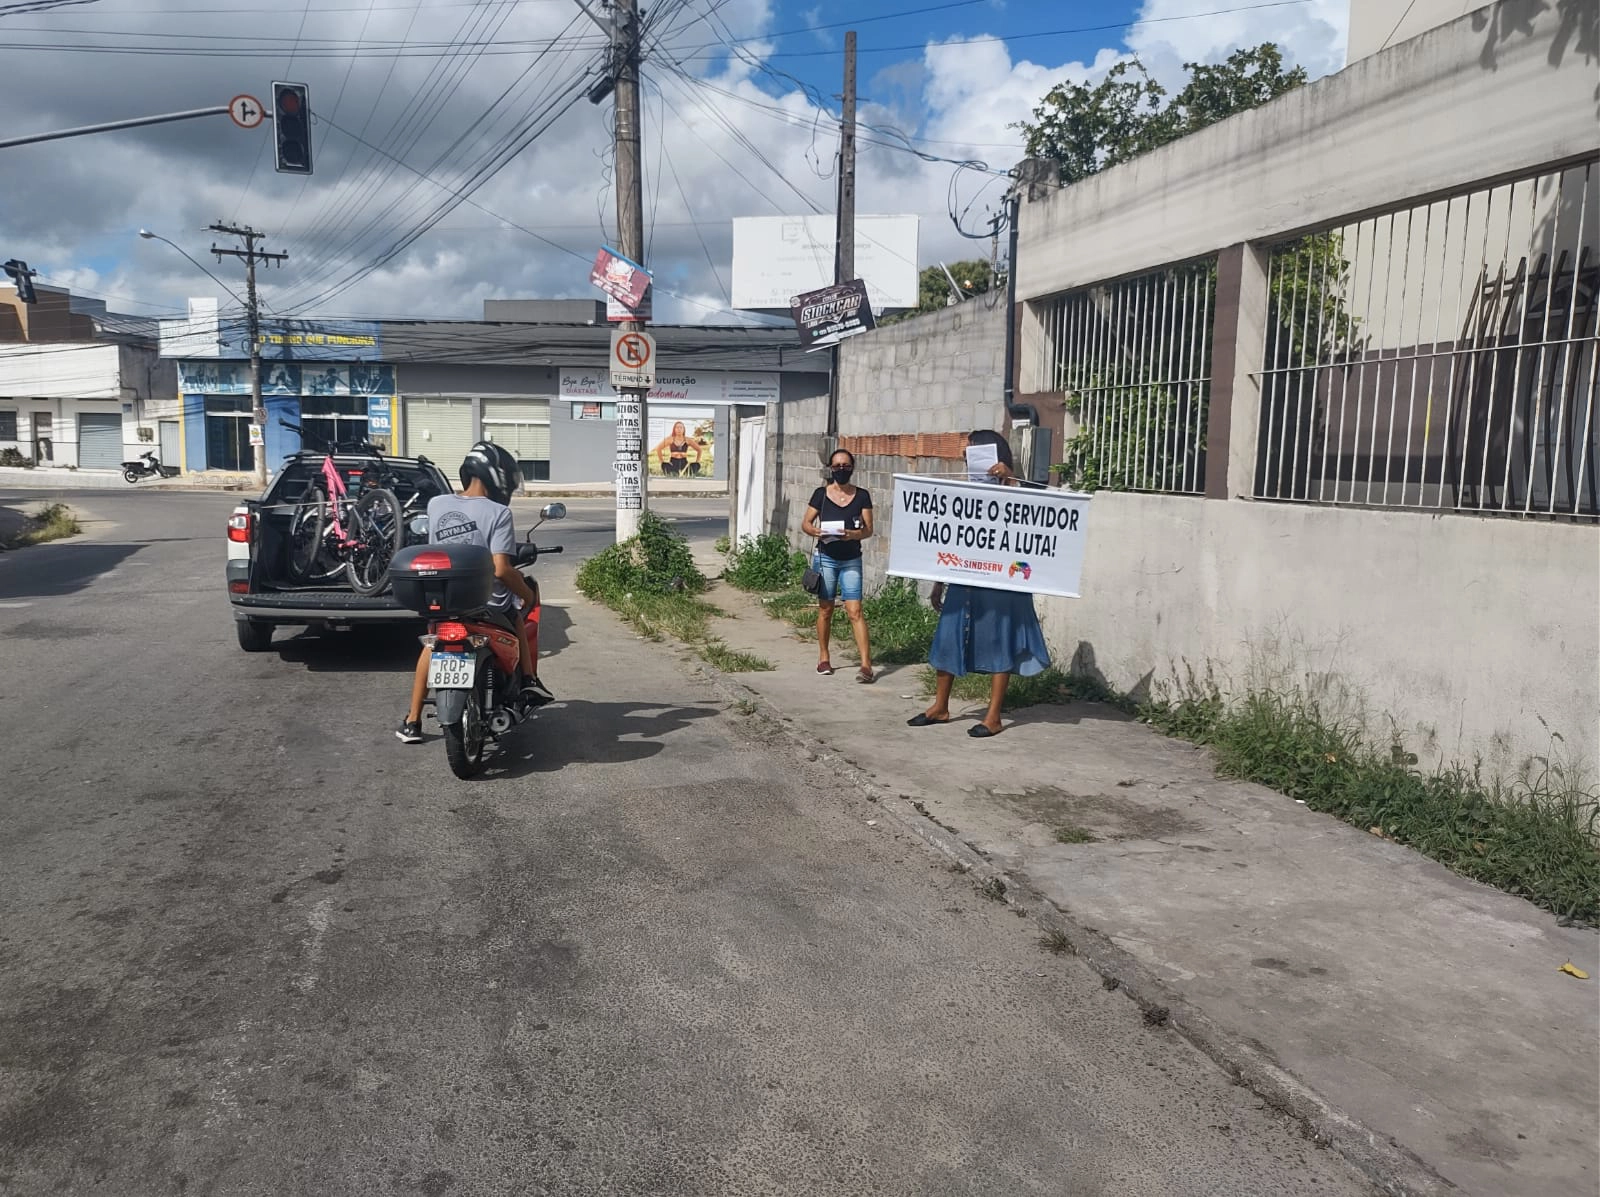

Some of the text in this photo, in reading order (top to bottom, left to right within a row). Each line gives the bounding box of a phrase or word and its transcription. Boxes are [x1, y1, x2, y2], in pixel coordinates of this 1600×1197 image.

[804, 296, 859, 321] STOCKCAR
[306, 335, 324, 344] QUE
[902, 487, 1079, 532] VERÁS QUE O SERVIDOR
[918, 516, 952, 545] NÃO
[956, 525, 997, 550] FOGE
[1015, 531, 1057, 558] LUTA!
[963, 559, 1004, 573] SINDSERV
[440, 659, 466, 672] RQP
[434, 672, 469, 685] 8B89
